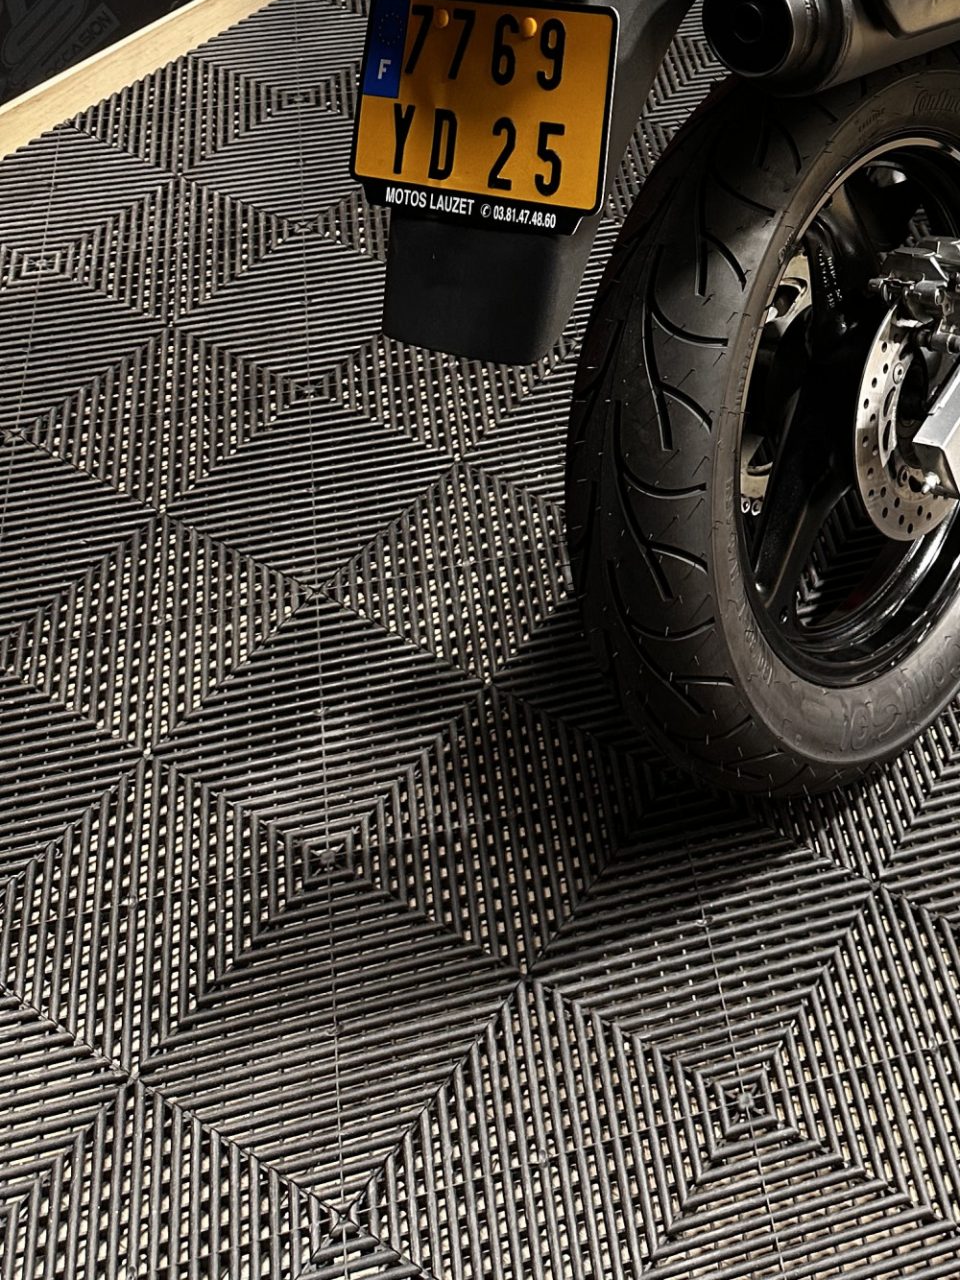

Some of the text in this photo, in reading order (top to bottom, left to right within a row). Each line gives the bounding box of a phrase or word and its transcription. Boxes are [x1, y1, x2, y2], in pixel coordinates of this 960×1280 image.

[377, 58, 392, 80] F
[404, 4, 567, 92] 7769
[392, 102, 566, 198] YD 25
[385, 186, 557, 229] MOTOS LAUZET 03.81.47.48.60
